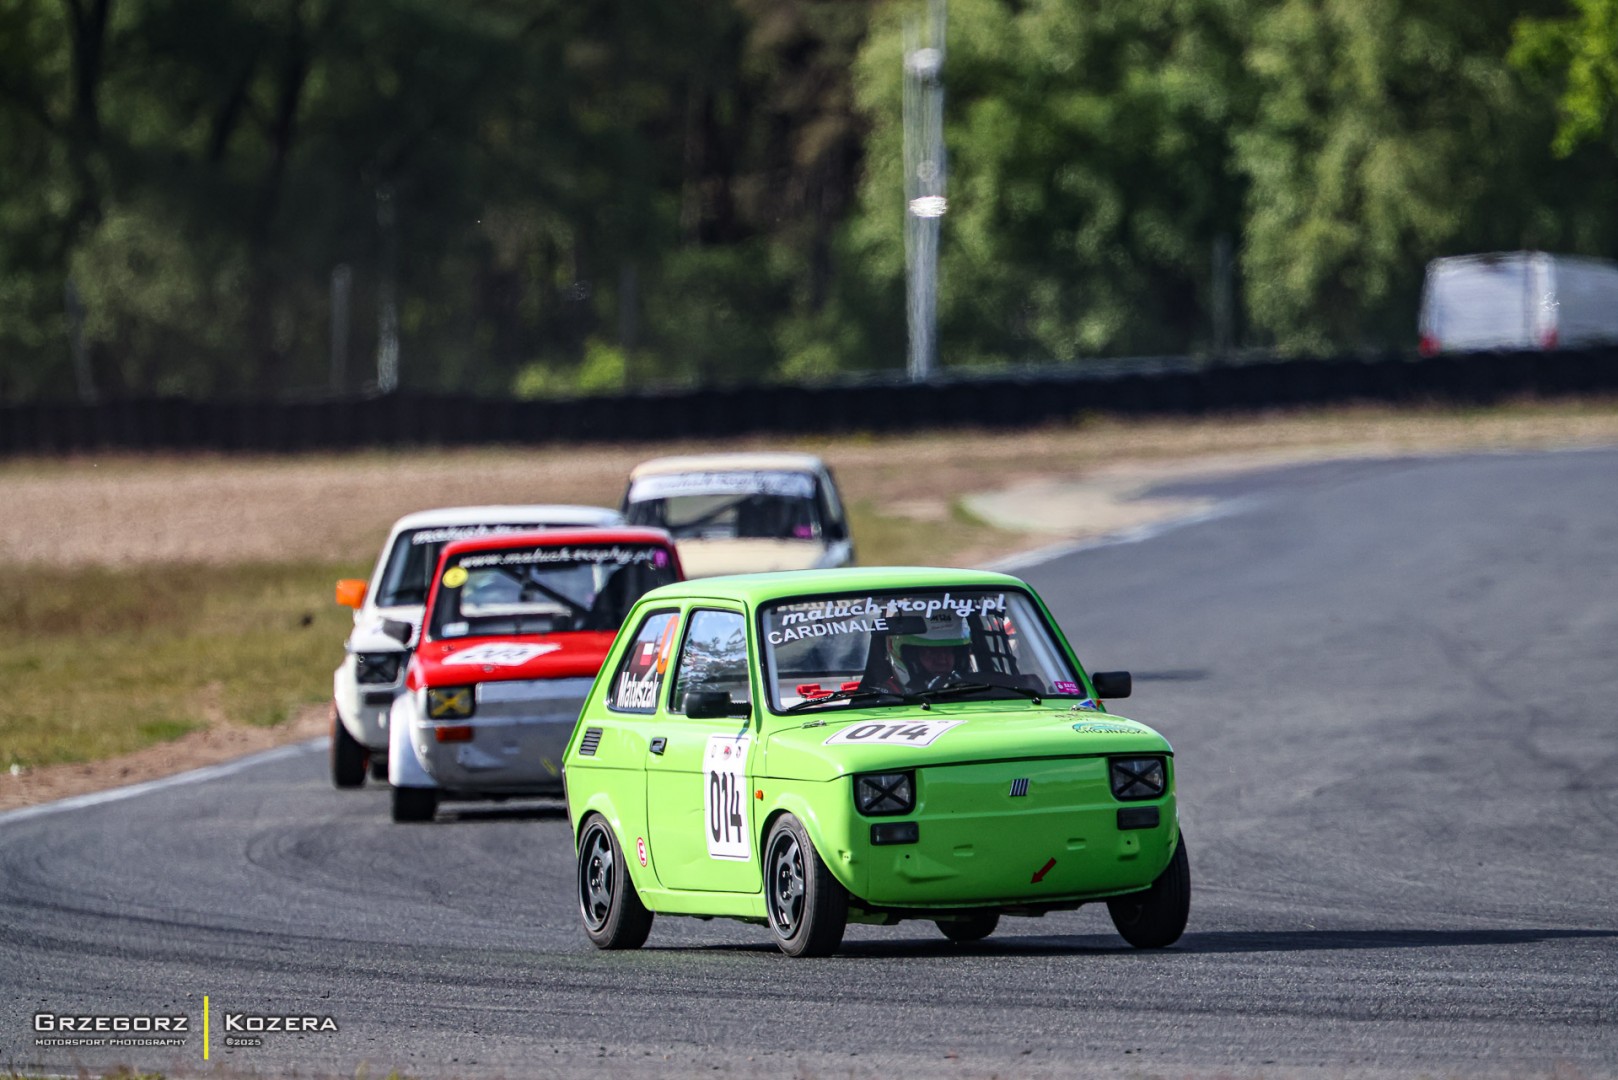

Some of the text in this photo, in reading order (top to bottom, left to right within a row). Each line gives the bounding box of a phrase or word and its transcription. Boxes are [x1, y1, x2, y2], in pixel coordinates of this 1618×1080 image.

[782, 592, 1007, 626] maluch-trophy.pl
[767, 618, 889, 645] CARDINALE
[617, 671, 660, 708] Matuszak
[845, 723, 930, 741] 014
[710, 770, 742, 844] 014
